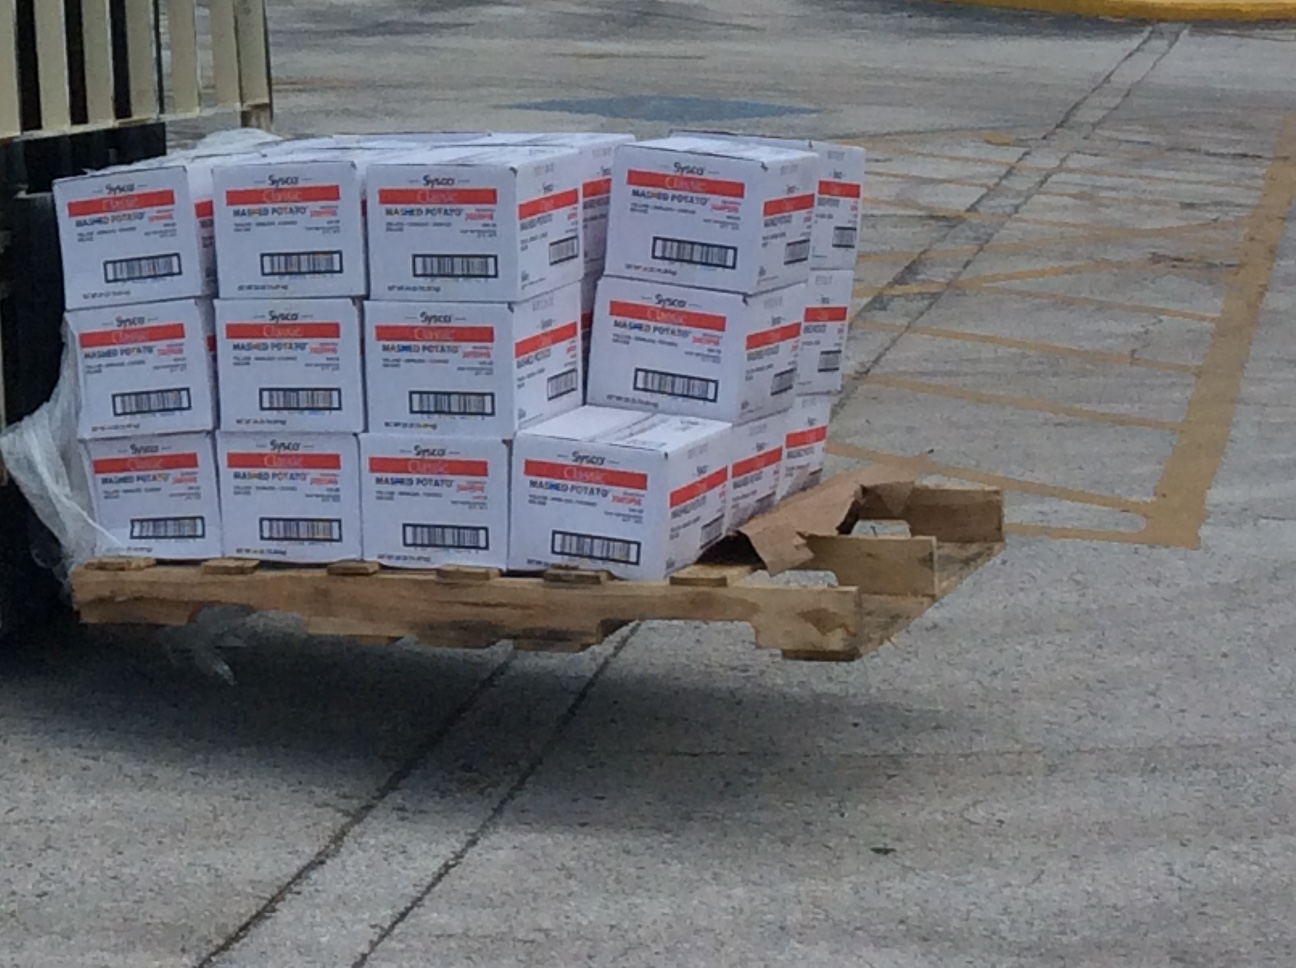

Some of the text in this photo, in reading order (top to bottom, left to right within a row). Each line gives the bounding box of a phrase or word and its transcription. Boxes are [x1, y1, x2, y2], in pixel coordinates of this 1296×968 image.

[673, 161, 705, 176] Sysco
[268, 174, 299, 188] Sysco
[423, 175, 455, 188] Sysco
[654, 293, 687, 308] Sysco
[115, 315, 145, 328] Sysco
[268, 310, 299, 324] Sysco
[419, 311, 452, 325] Sysco
[269, 439, 301, 453] Sysco
[413, 445, 447, 459] Sysco
[571, 451, 606, 466] Sysco
